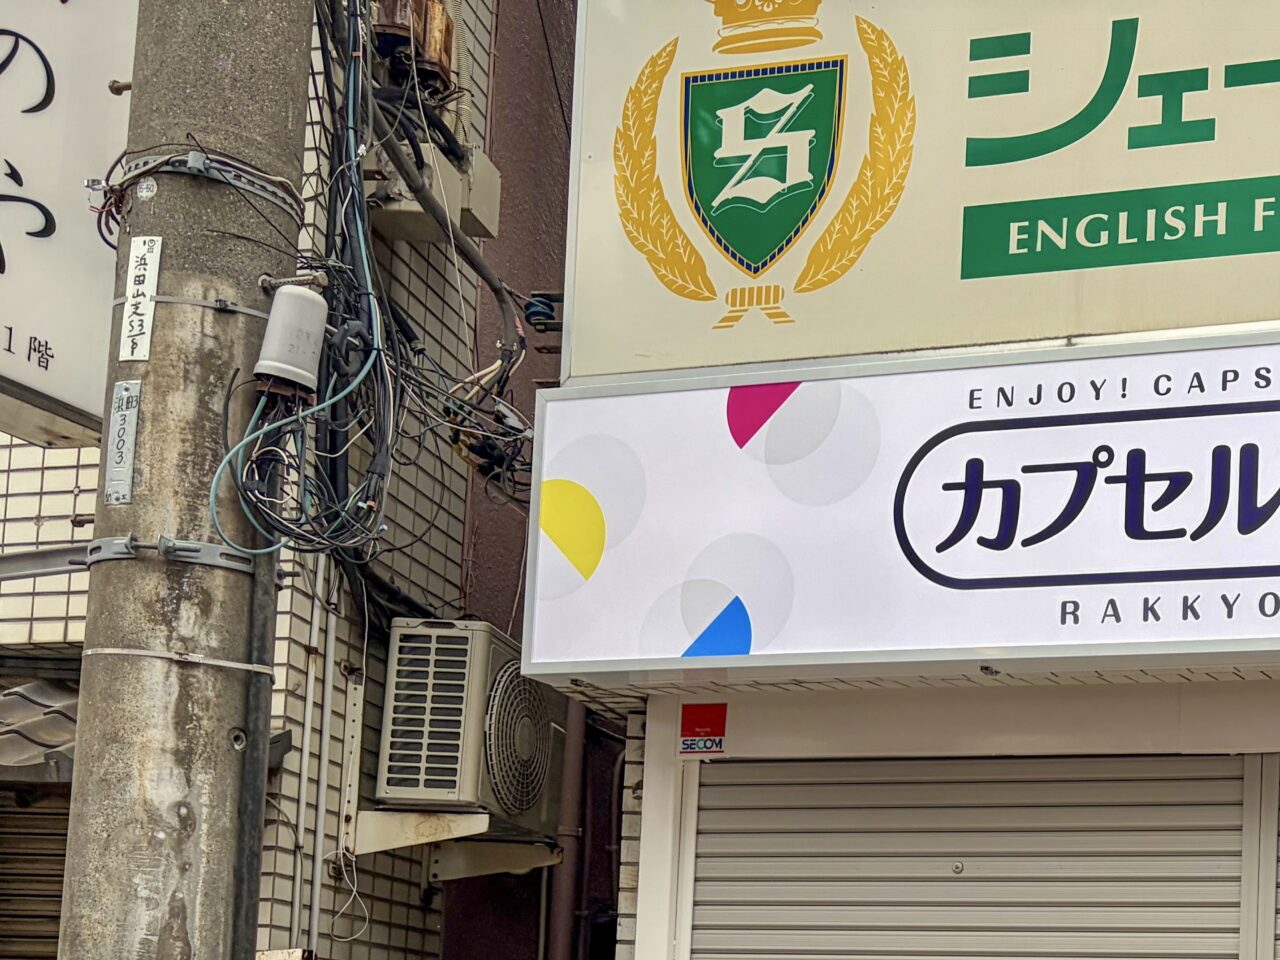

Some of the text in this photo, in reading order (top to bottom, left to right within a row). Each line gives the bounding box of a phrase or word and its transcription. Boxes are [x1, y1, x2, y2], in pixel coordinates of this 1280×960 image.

[1007, 202, 1228, 255] ENGLISH
[3, 325, 55, 371] 1階
[968, 376, 1129, 410] ENJOY!
[115, 414, 127, 465] 3003
[681, 738, 723, 750] SECOM
